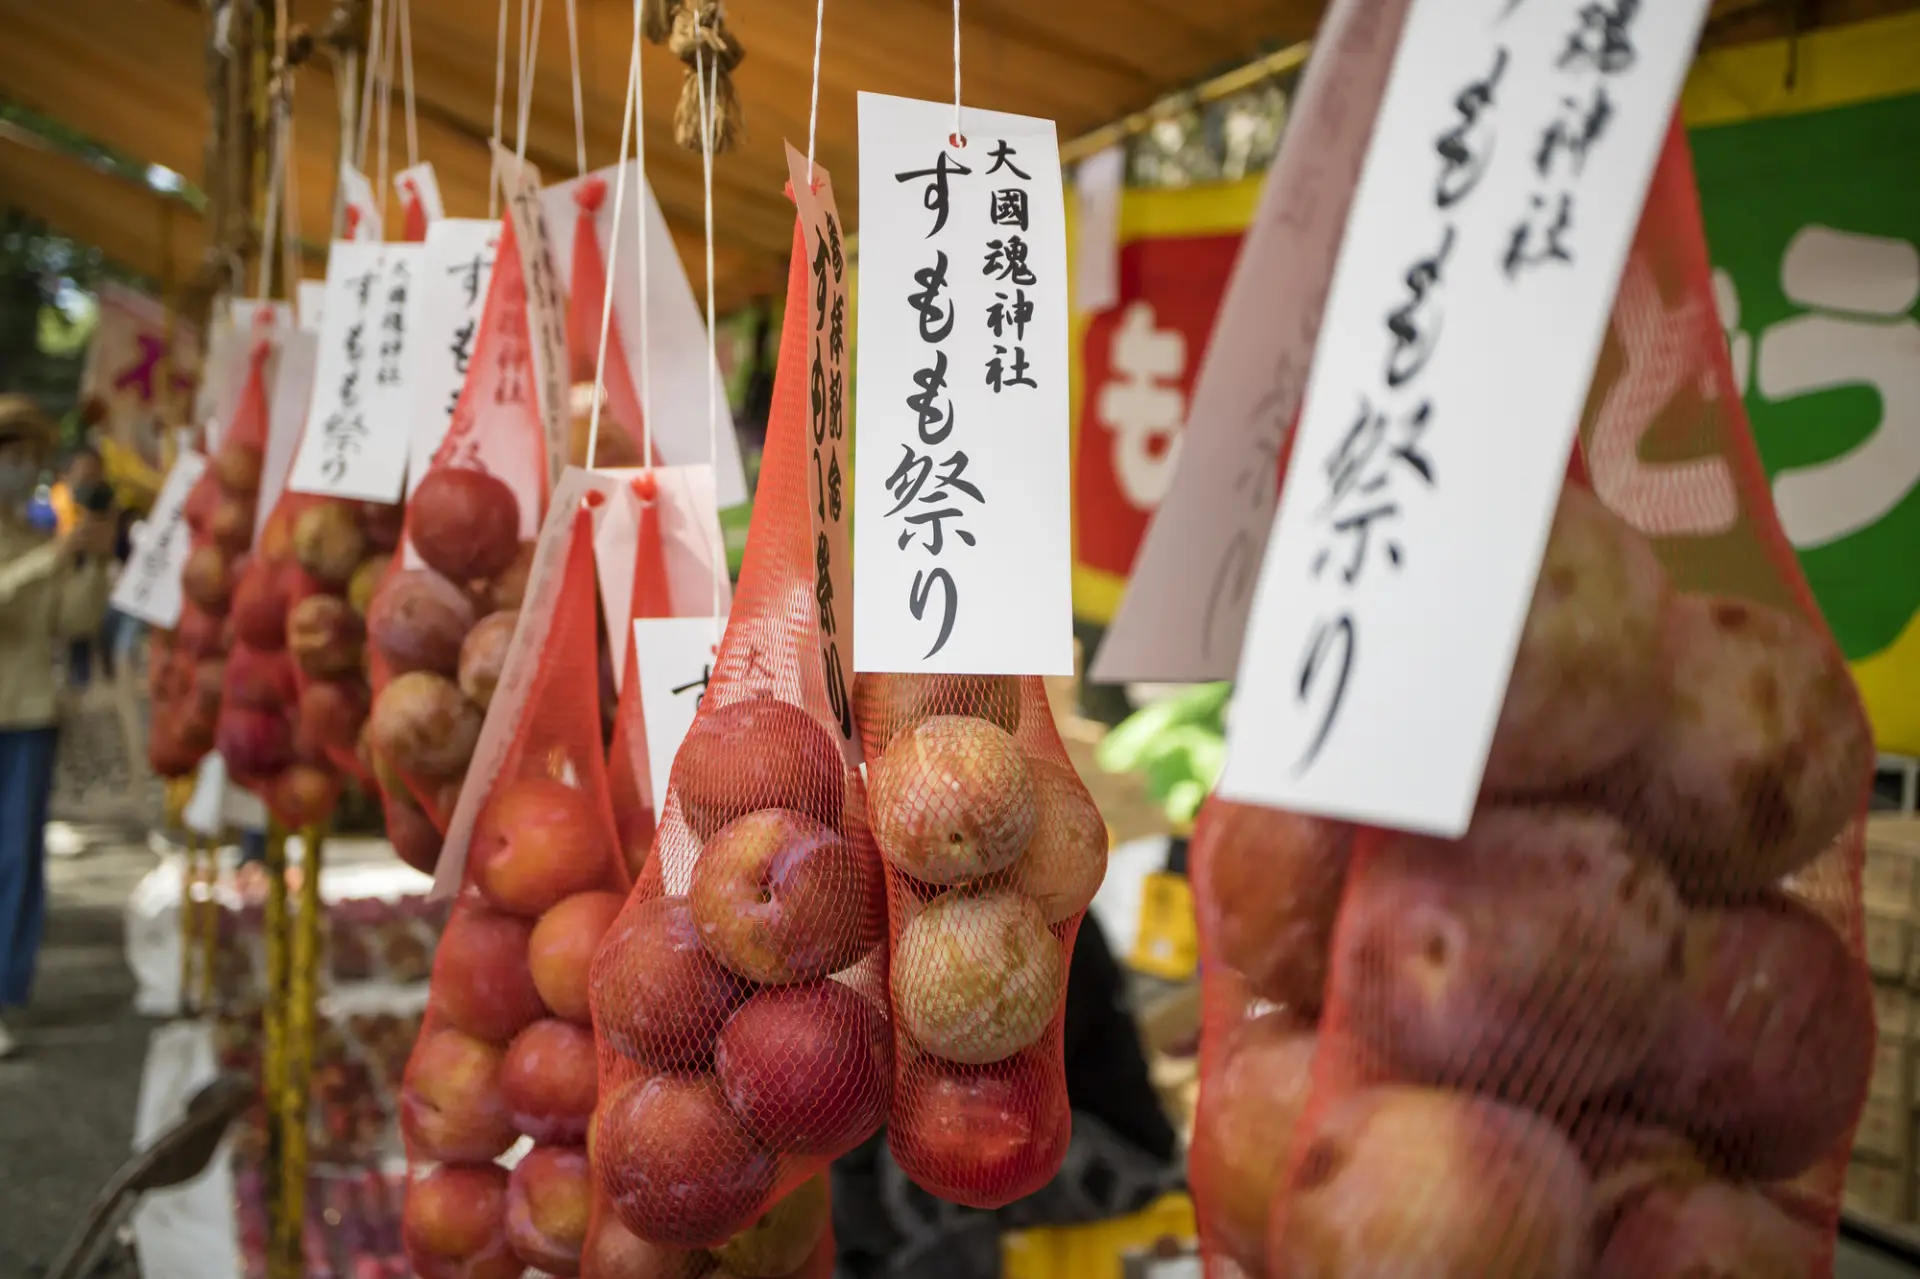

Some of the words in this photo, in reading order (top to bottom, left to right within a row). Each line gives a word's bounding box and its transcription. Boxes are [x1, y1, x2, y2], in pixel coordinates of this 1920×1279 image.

[883, 150, 986, 660] すもも祭り
[982, 139, 1038, 394] 大國魂神社
[1096, 300, 1188, 512] も
[1294, 0, 1518, 775] もも祭り
